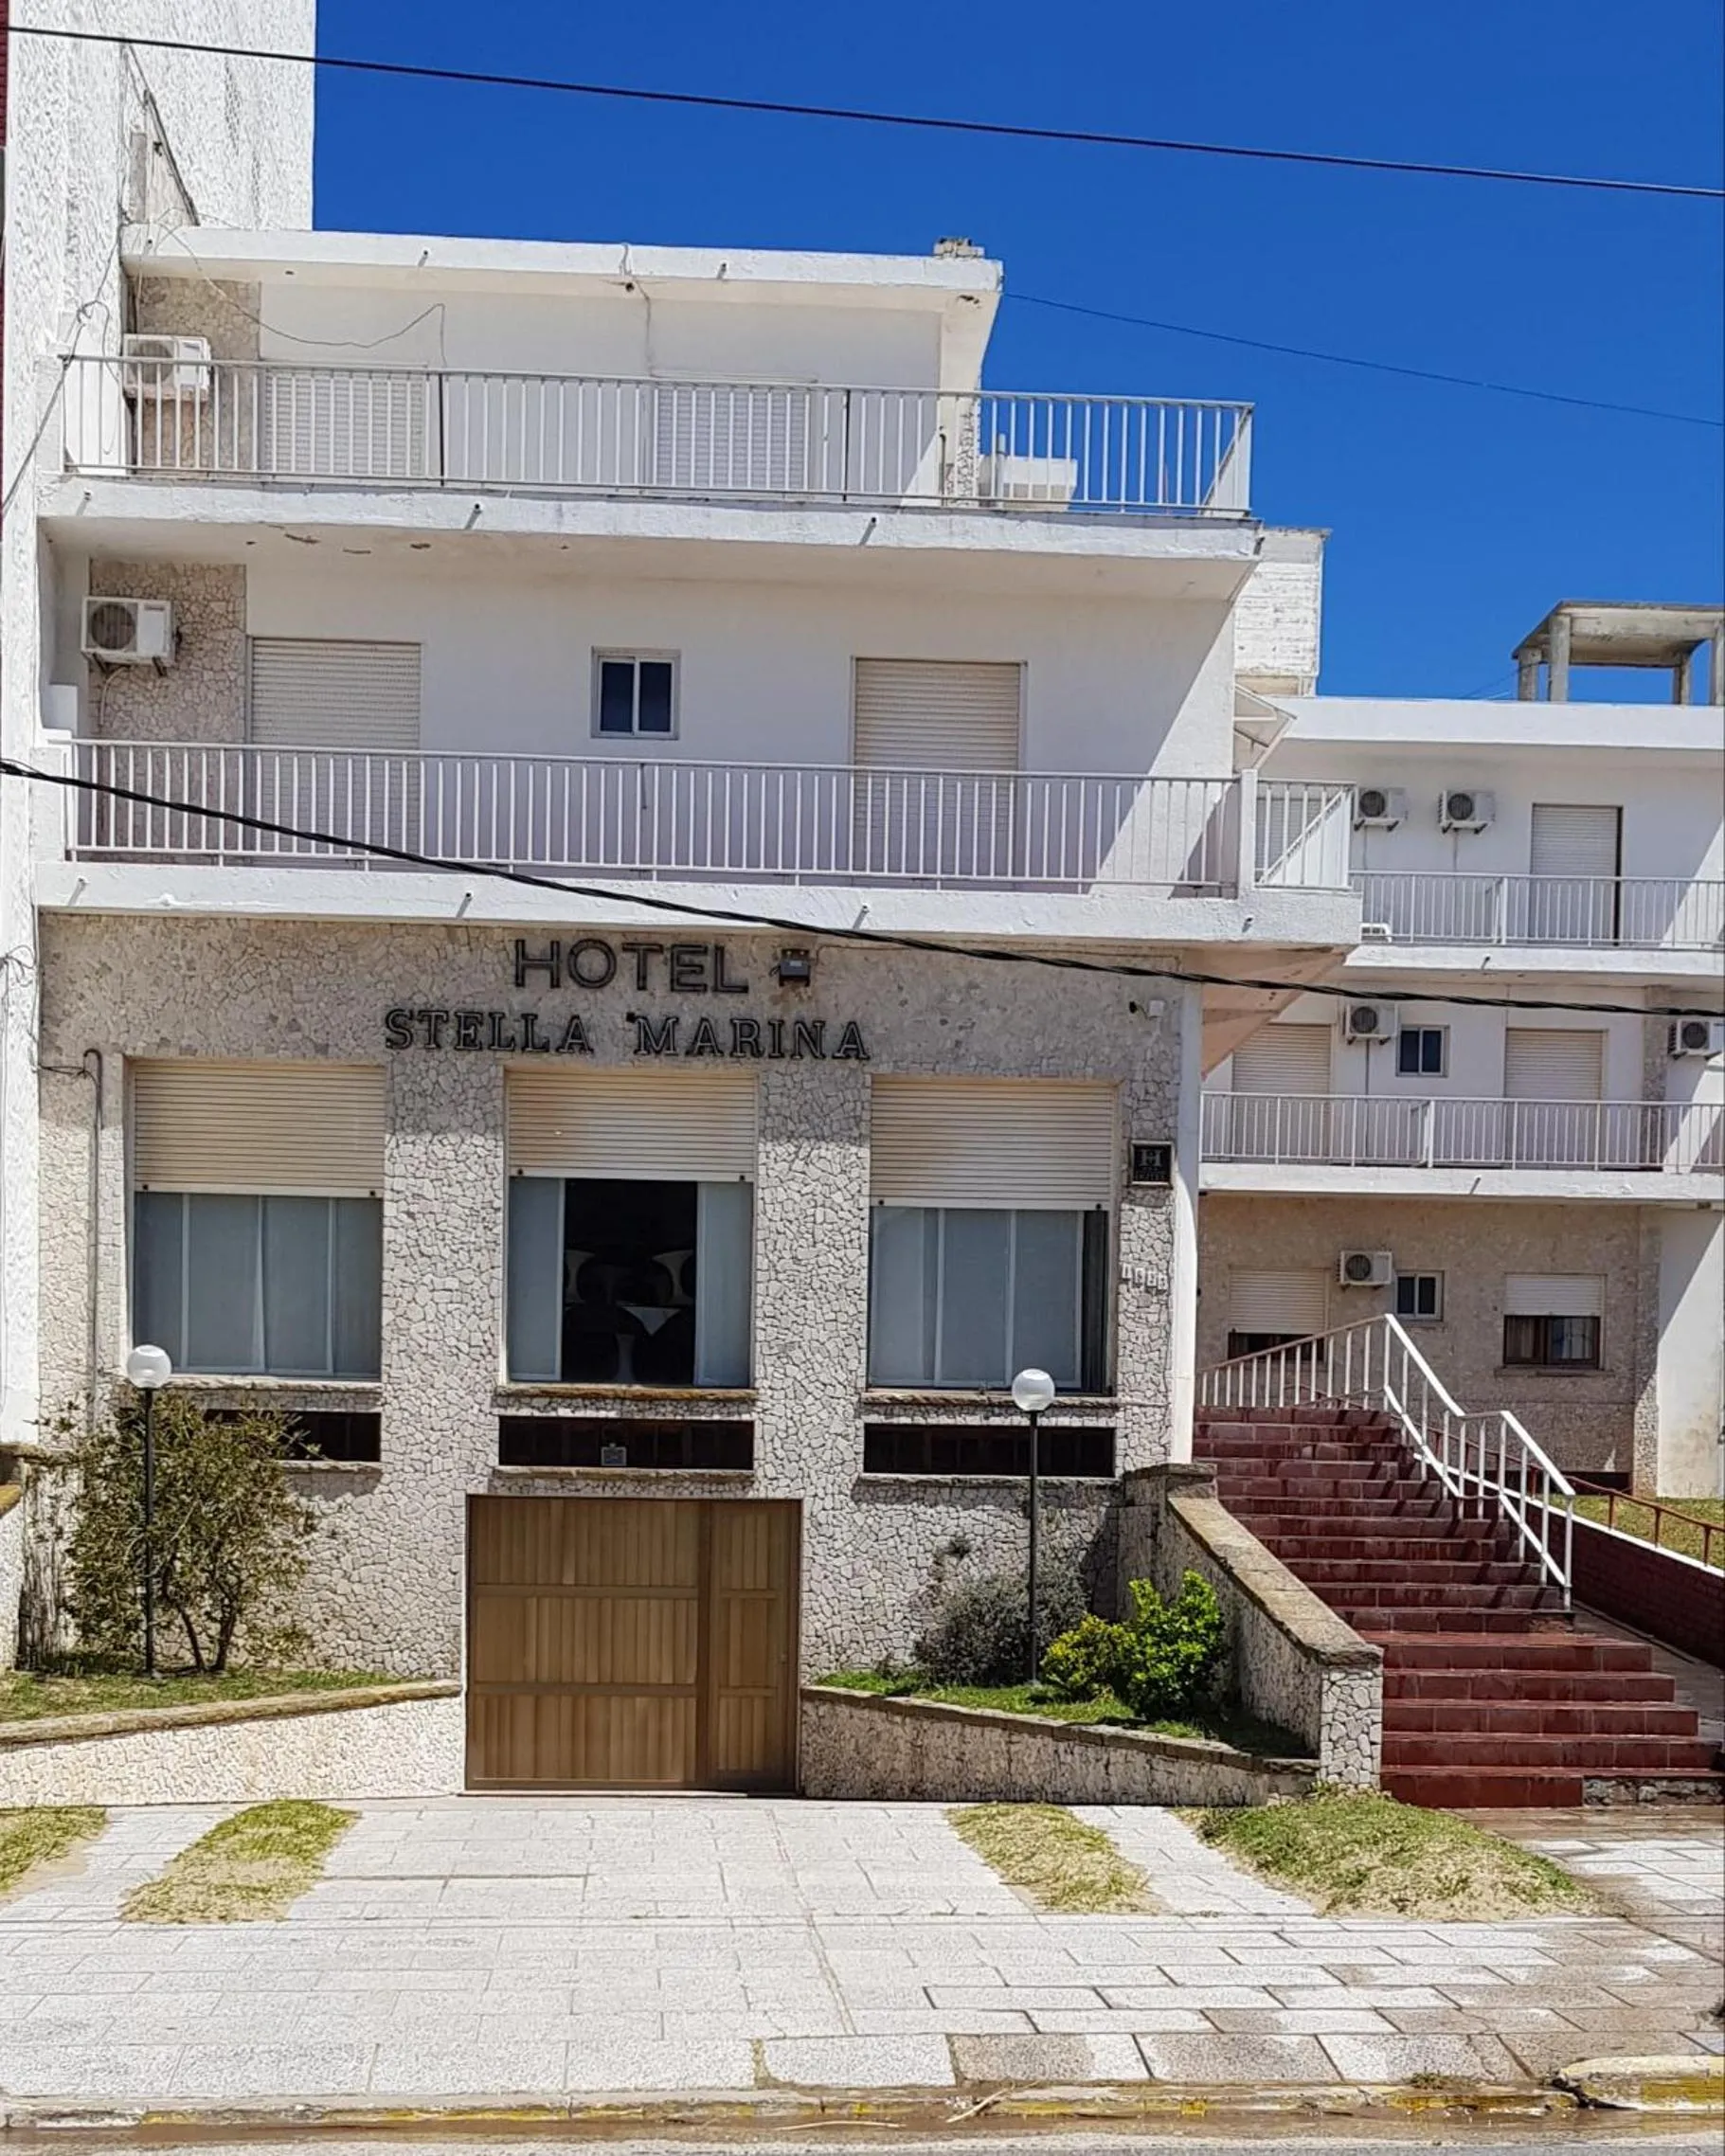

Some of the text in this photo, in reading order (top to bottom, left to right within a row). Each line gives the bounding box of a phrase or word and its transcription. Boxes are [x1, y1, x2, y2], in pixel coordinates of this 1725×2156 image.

[514, 939, 749, 994] HOTEL
[386, 1008, 871, 1060] STELLA MARINA
